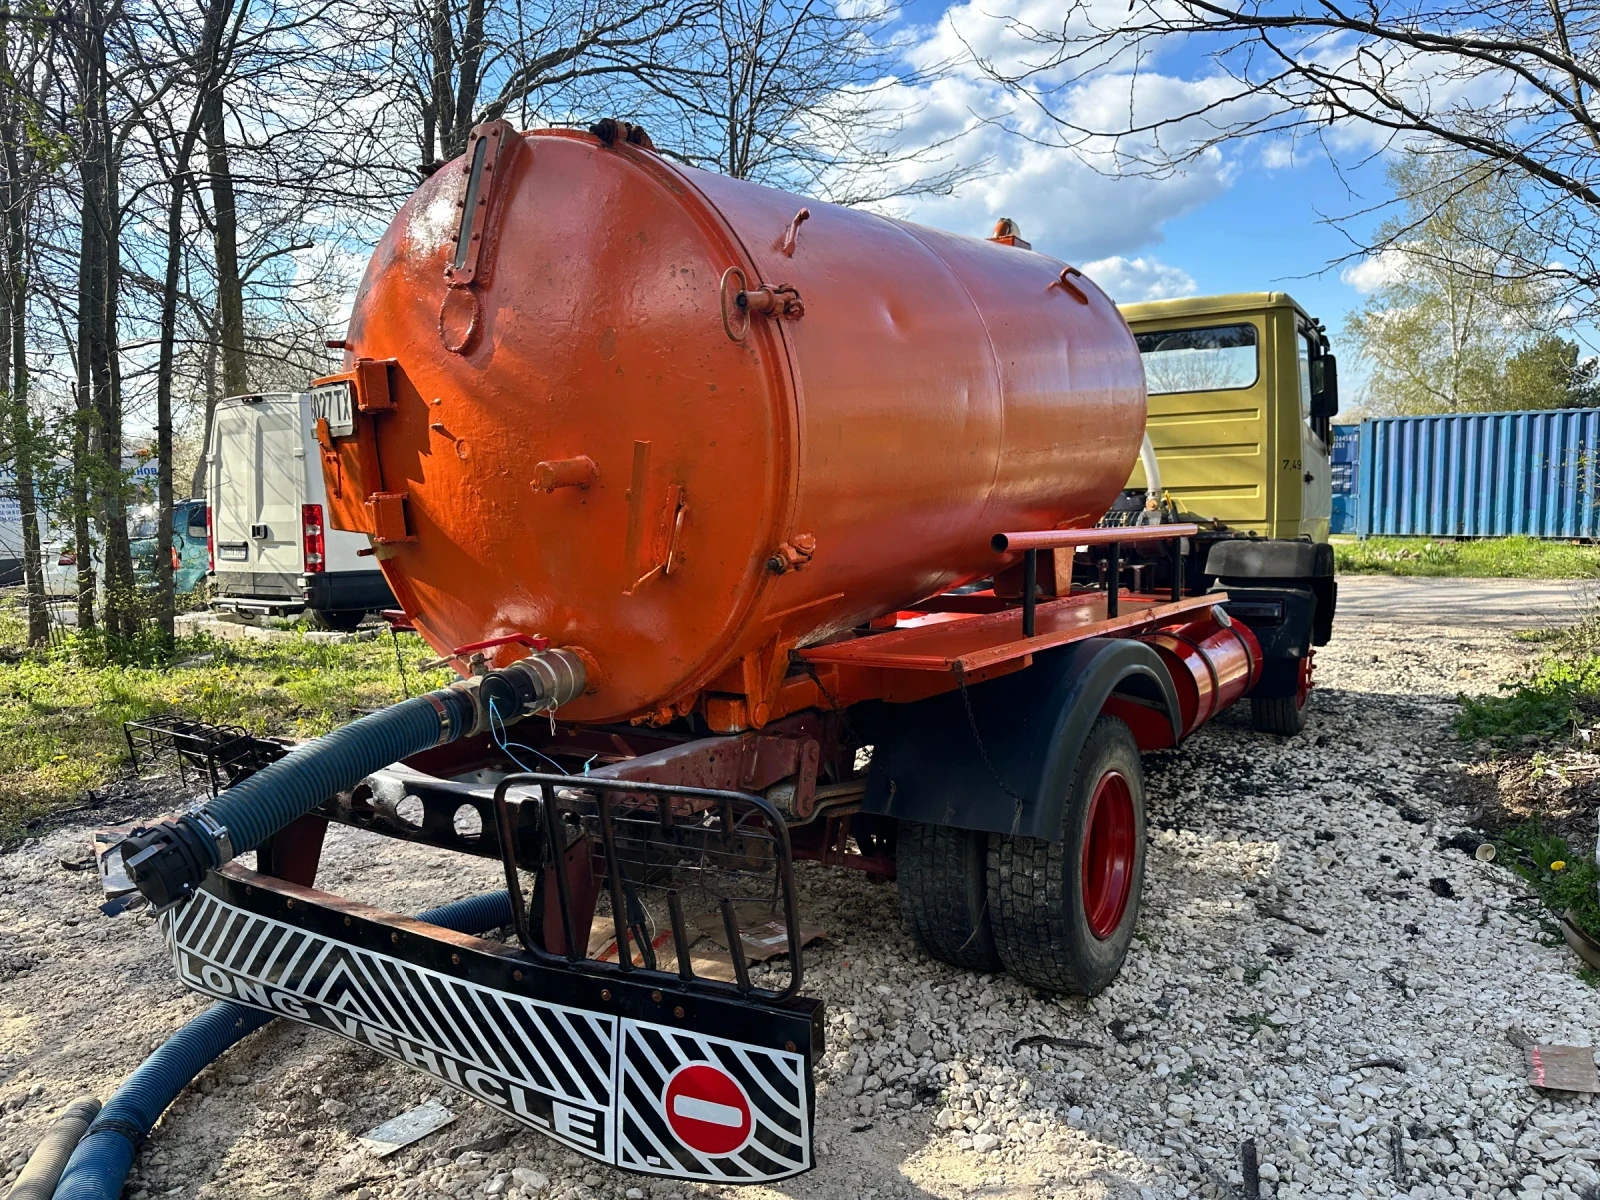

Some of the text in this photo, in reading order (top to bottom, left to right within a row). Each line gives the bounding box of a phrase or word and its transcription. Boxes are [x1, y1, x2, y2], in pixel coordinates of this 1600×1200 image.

[333, 389, 351, 421] TX
[180, 950, 598, 1149] LONG VEHICLE
